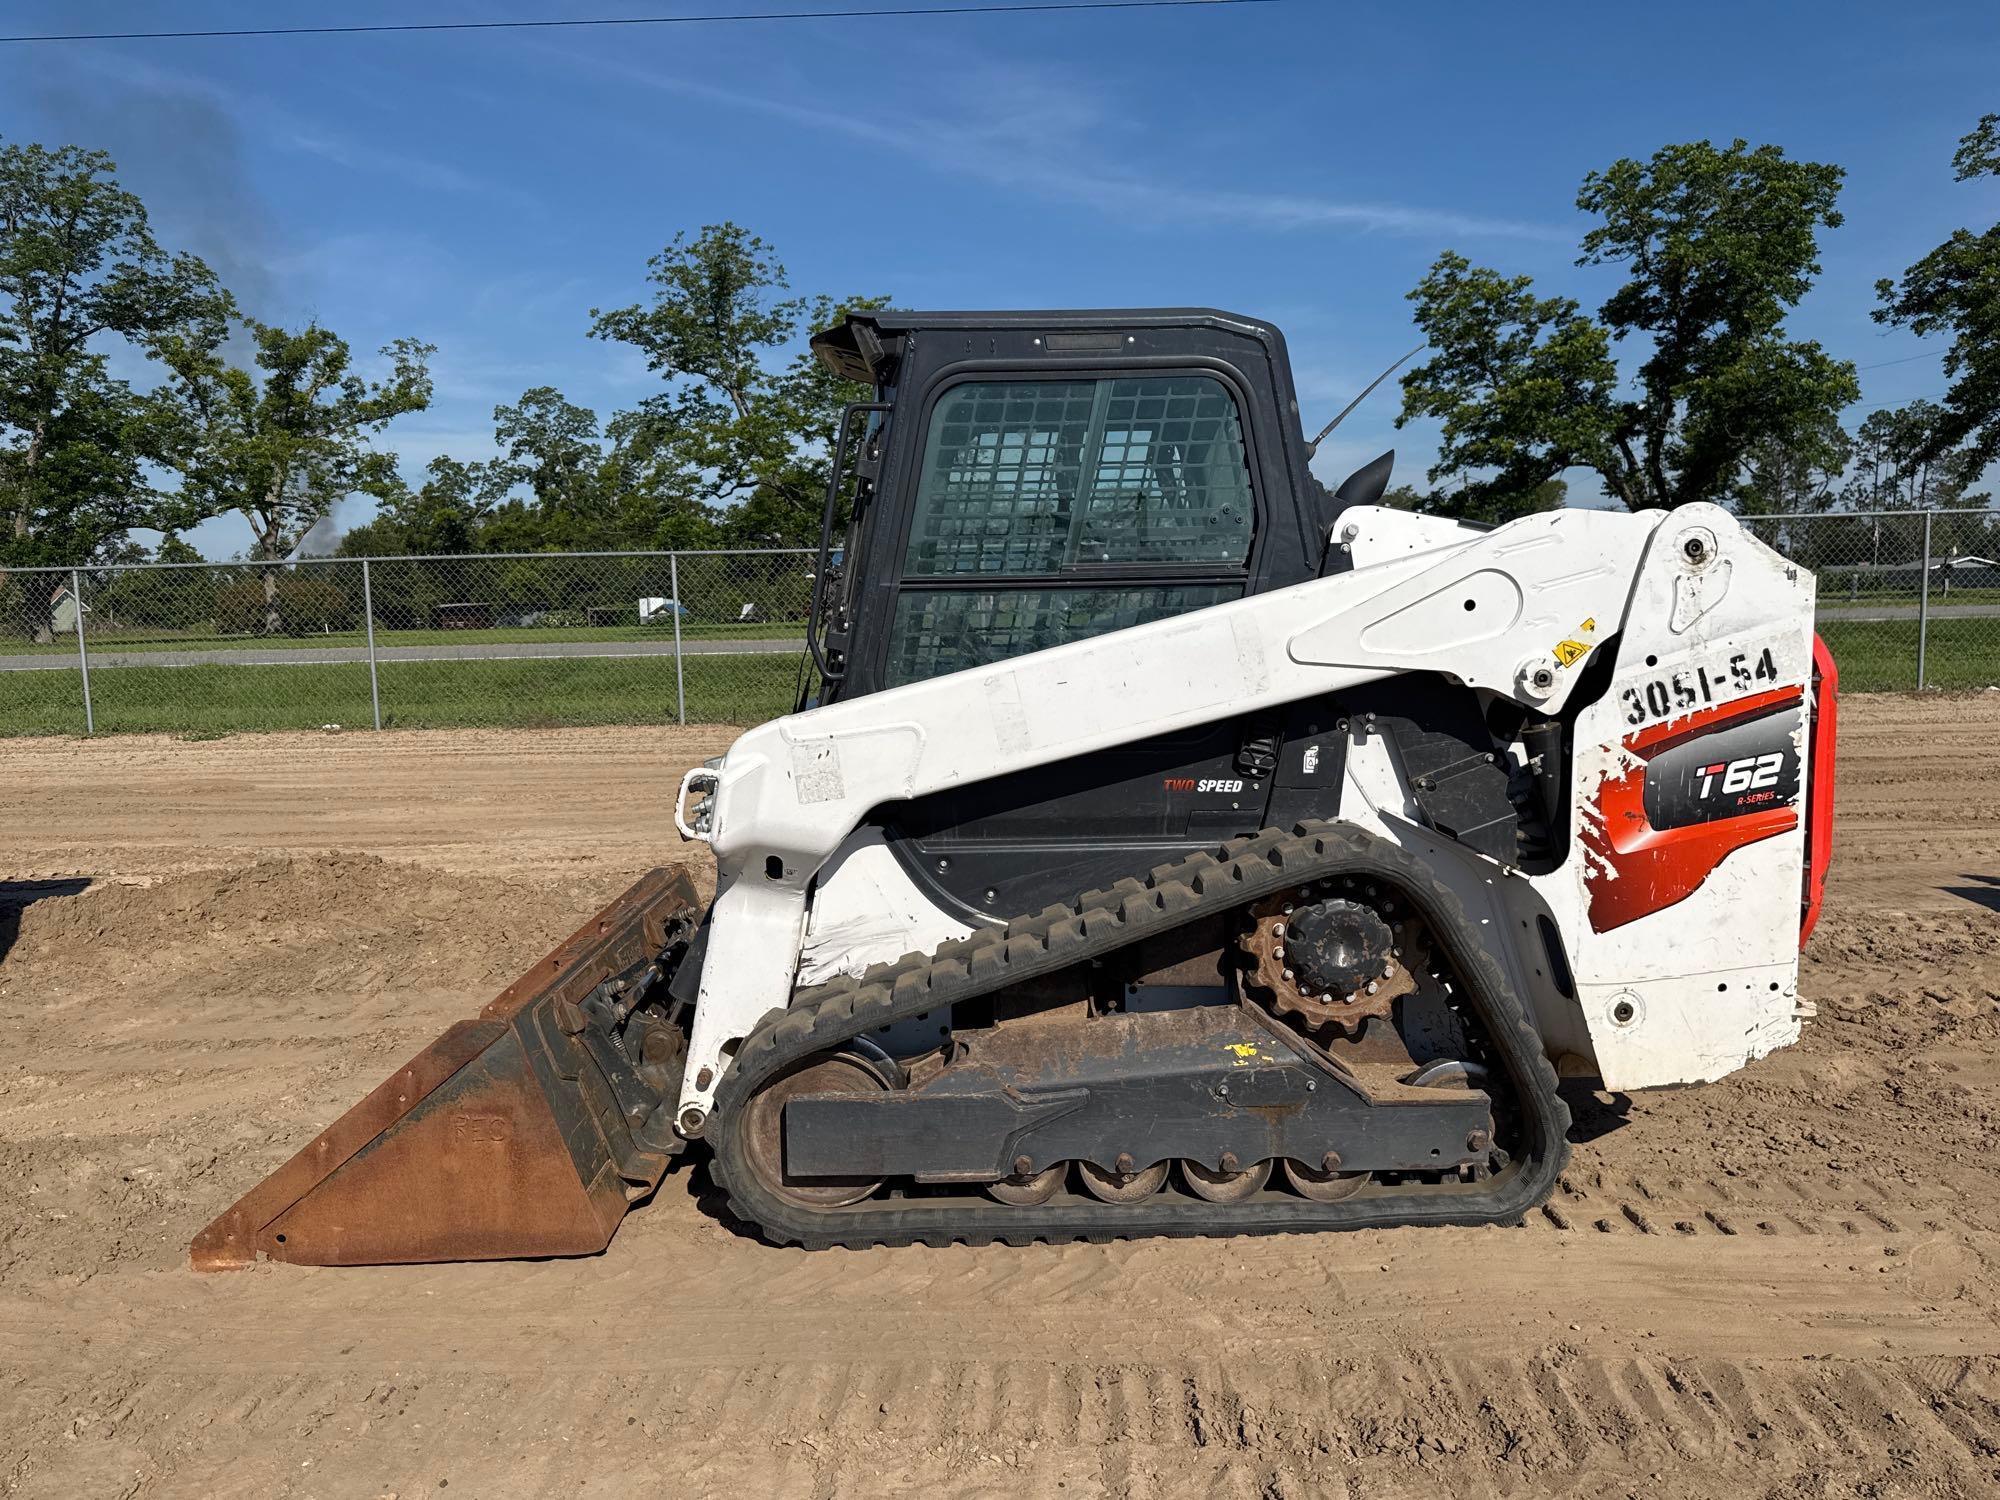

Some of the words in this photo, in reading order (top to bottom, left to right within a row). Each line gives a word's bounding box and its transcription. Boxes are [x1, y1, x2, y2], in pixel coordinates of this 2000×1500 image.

[1622, 647, 1777, 725] 3051-54
[1163, 779, 1196, 793] TWO
[1197, 779, 1243, 793] SPEED
[1696, 752, 1784, 799] T62
[1737, 790, 1776, 806] R-SERIES
